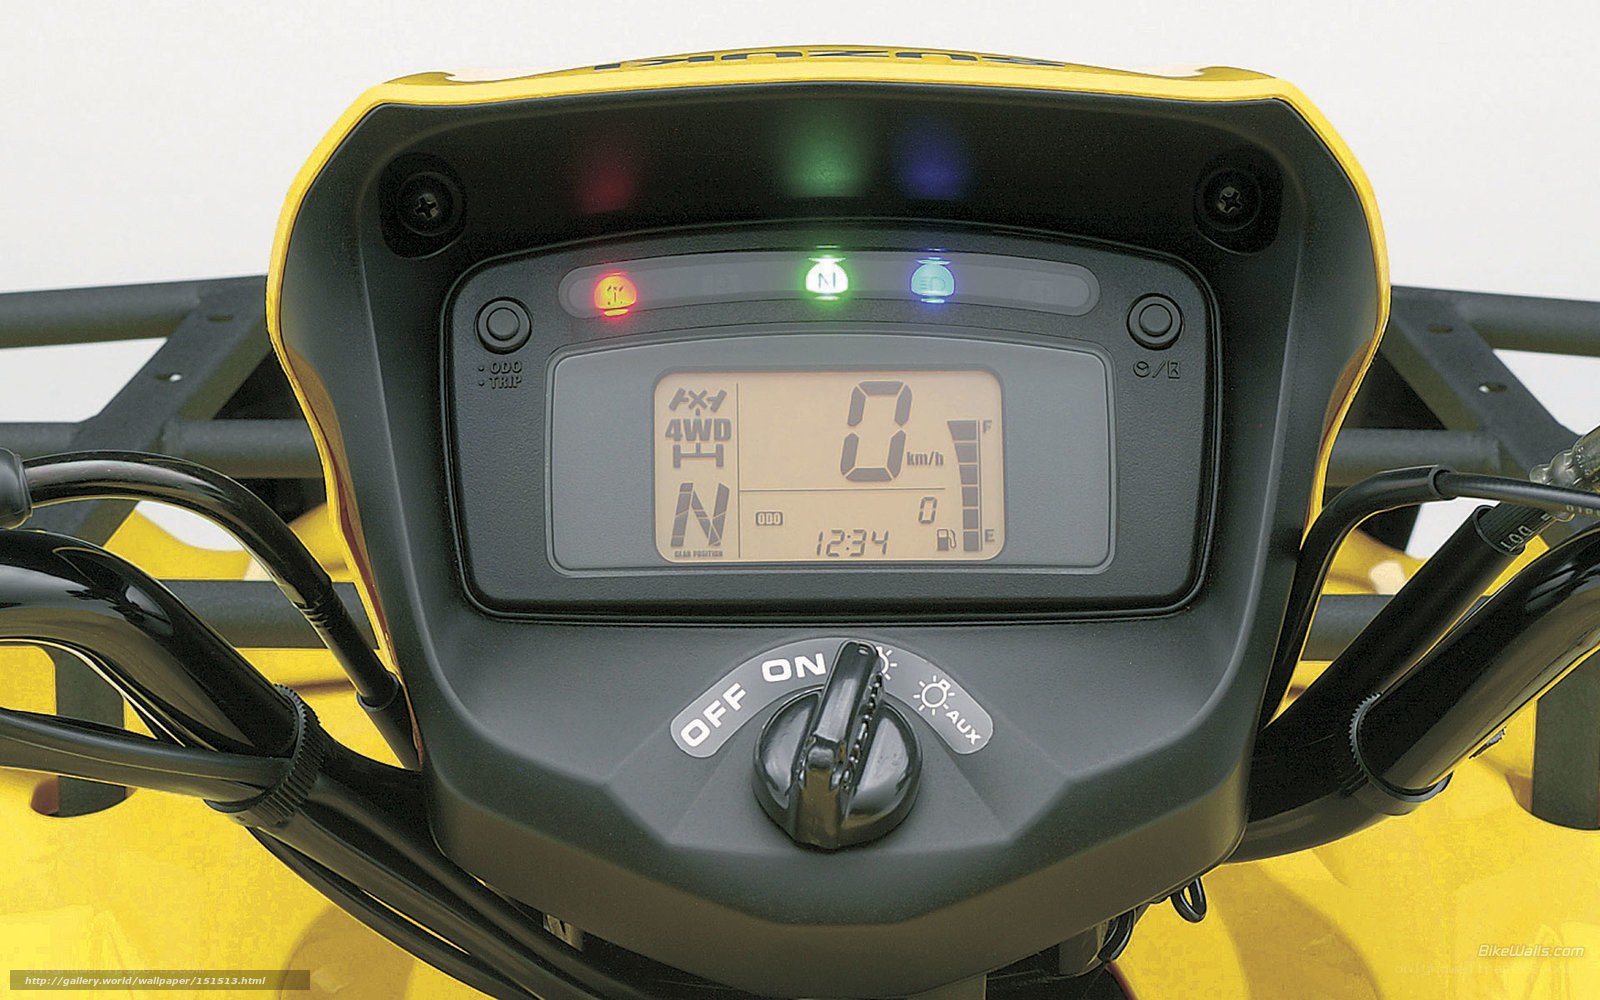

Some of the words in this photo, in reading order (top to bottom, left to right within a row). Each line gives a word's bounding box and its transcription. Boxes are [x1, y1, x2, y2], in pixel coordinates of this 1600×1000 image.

[490, 361, 523, 374] ODO
[489, 375, 523, 389] TRIP
[665, 418, 732, 442] 4WD
[840, 380, 913, 483] 0
[982, 420, 993, 433] F
[906, 451, 945, 467] km/h
[670, 482, 730, 547] N
[757, 512, 782, 526] ODO
[918, 496, 938, 524] 0
[816, 529, 890, 557] 12:34
[984, 529, 995, 543] E
[761, 653, 827, 683] ON
[680, 681, 748, 748] OFF
[945, 710, 982, 745] AUX
